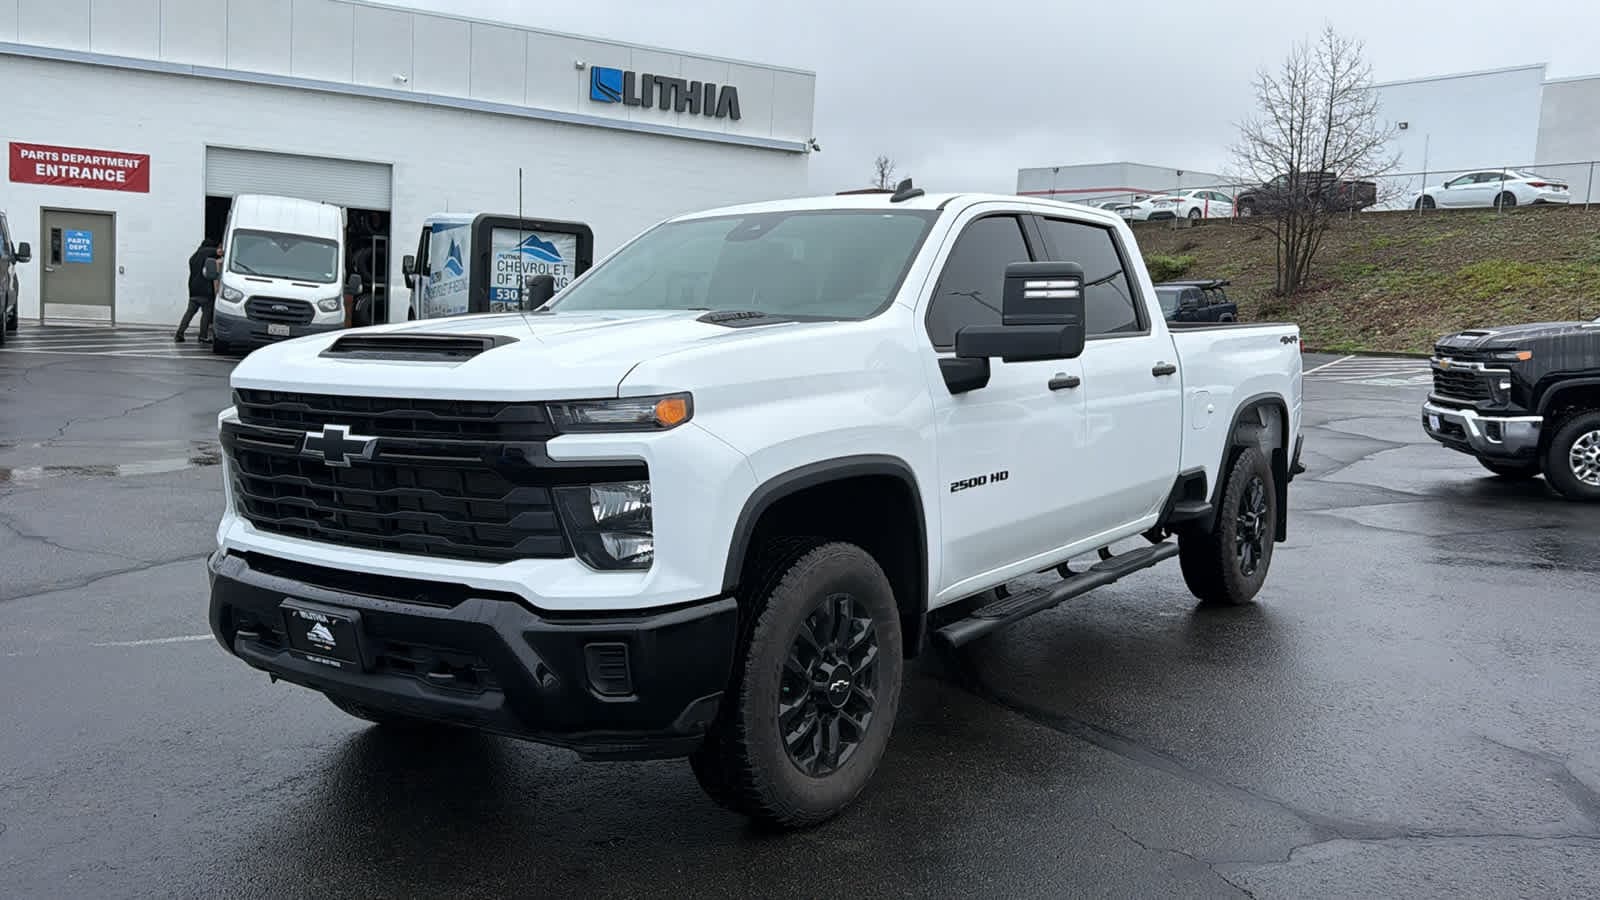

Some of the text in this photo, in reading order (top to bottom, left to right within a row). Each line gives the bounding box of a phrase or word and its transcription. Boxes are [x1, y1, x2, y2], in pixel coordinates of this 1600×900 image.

[623, 71, 741, 120] LITHIA
[20, 149, 140, 169] PARTS DEPARTMENT
[35, 163, 126, 182] ENTRANCE
[496, 260, 569, 276] CHEVROLET
[496, 273, 512, 285] OF
[950, 470, 1009, 493] 2500 HD
